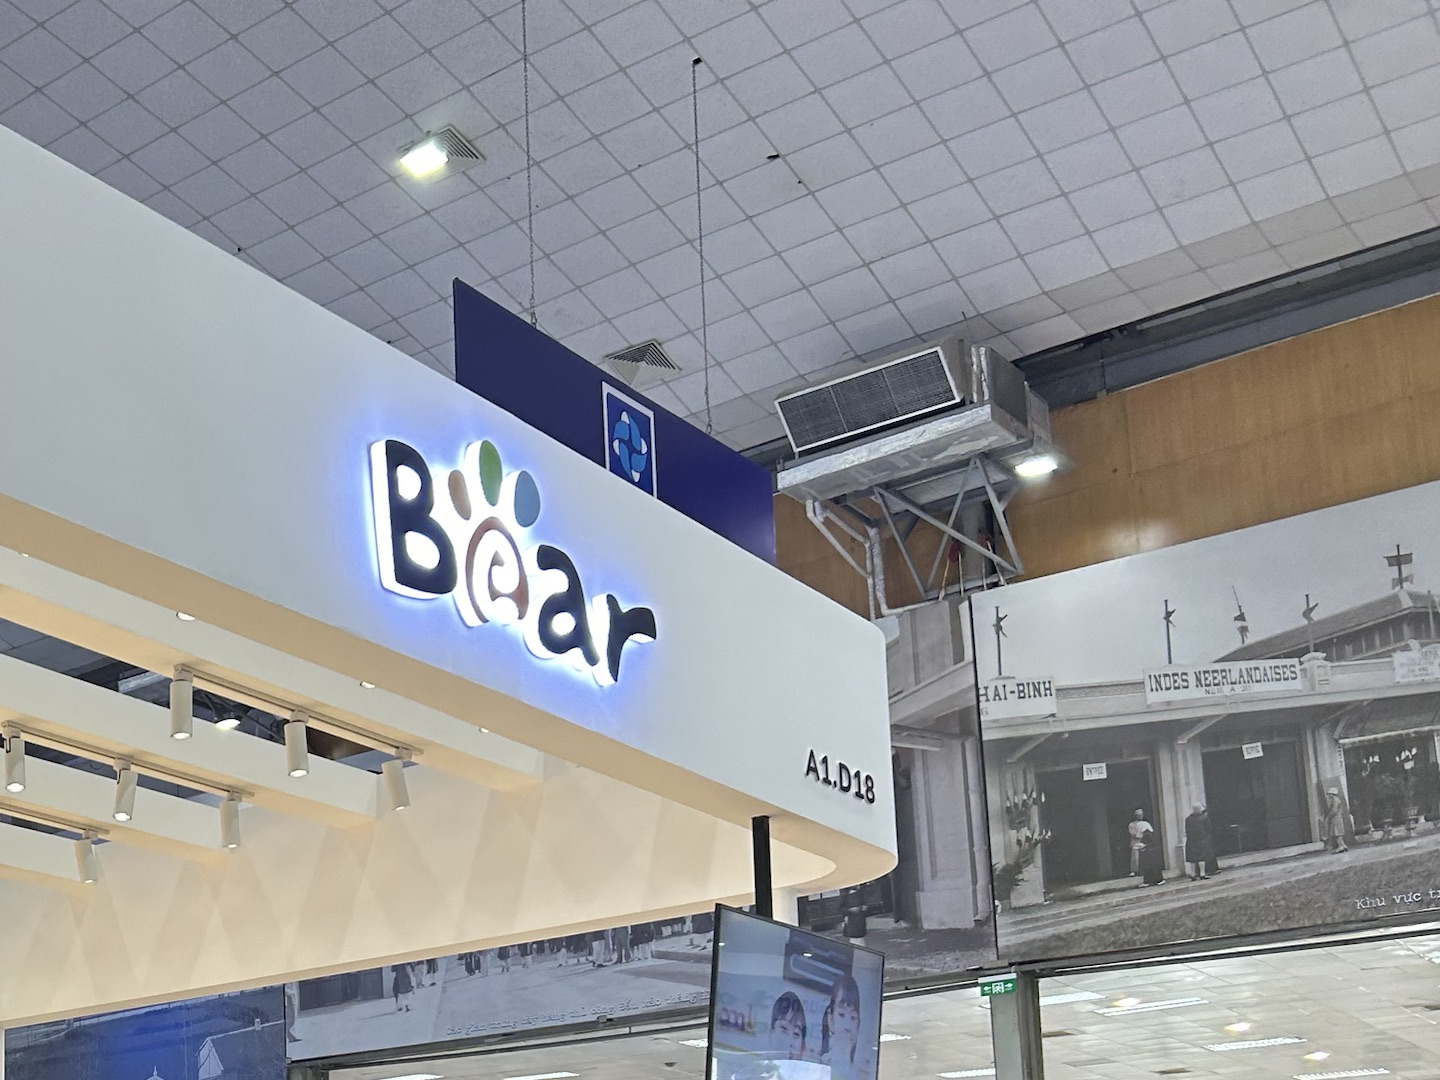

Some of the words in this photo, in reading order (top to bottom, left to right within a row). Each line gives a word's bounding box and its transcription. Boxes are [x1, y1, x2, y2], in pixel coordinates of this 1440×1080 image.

[371, 440, 657, 686] Bear
[1148, 672, 1189, 692] INDES
[1194, 664, 1298, 688] NEERLANDAISES
[805, 749, 875, 804] A1.D18
[1356, 897, 1387, 909] Khu
[1393, 892, 1421, 905] vực
